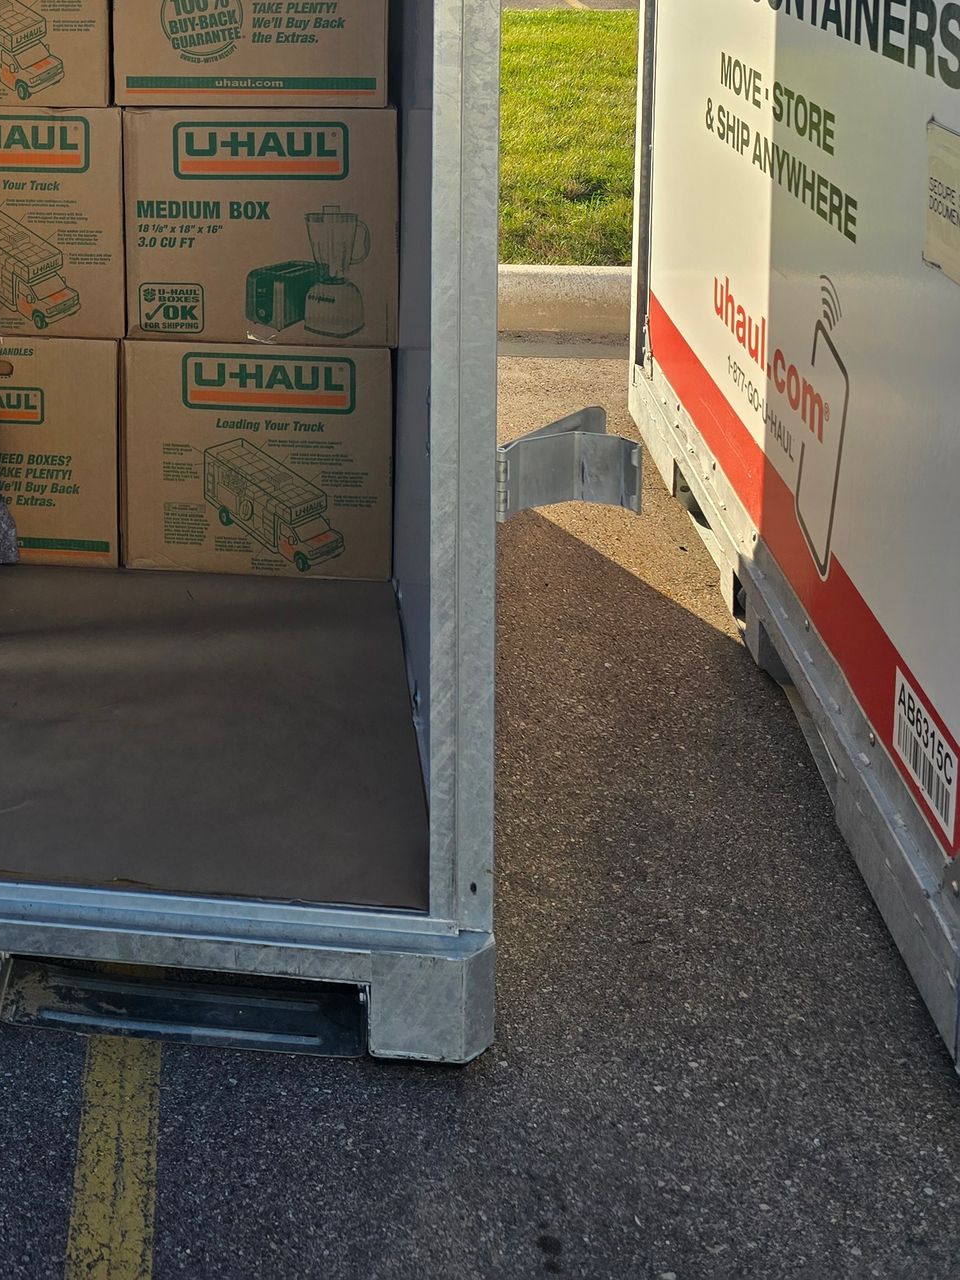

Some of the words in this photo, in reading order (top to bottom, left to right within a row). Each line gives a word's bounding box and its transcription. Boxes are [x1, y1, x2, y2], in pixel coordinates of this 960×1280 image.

[252, 2, 283, 14] TAKE
[286, 2, 337, 14] PLENTY!
[169, 10, 238, 35] BUY-BACK
[252, 17, 281, 29] We'll
[286, 18, 310, 32] Buy
[313, 17, 346, 29] Back
[172, 28, 241, 50] GUARANTEE
[252, 32, 272, 44] the
[276, 32, 319, 44] Extras.
[215, 79, 283, 88] uhaul.com
[721, 51, 762, 109] MOVE
[773, 81, 836, 156] STORE
[185, 132, 338, 157] U-HAUL
[706, 98, 714, 133] &
[717, 105, 750, 159] SHIP
[752, 136, 857, 244] ANYWHERE
[3, 179, 27, 191] Your
[30, 180, 60, 191] Truck
[137, 200, 221, 219] MEDIUM
[229, 201, 270, 220] BOX
[138, 224, 149, 234] 18
[178, 224, 195, 234] 18"
[206, 224, 223, 234] 16"
[138, 237, 157, 248] 3.0
[160, 237, 177, 248] CU
[180, 237, 195, 248] FT
[158, 288, 200, 296] U-HAUL
[158, 295, 200, 303] BOXES
[164, 305, 199, 321] OK
[162, 322, 199, 330] SHIPPING
[714, 276, 823, 444] uhaul.com
[194, 362, 345, 391] U-HAUL
[728, 355, 794, 462] 1-877-GO-U-HAUL
[216, 418, 260, 432] Loading
[264, 420, 289, 431] Your
[293, 421, 325, 432] Truck
[27, 454, 72, 467] BOXES?
[25, 468, 72, 480] PLENTY!
[25, 481, 47, 495] Buy
[50, 483, 80, 495] Back
[16, 495, 56, 507] Extras.
[898, 682, 953, 785] AB6315C
